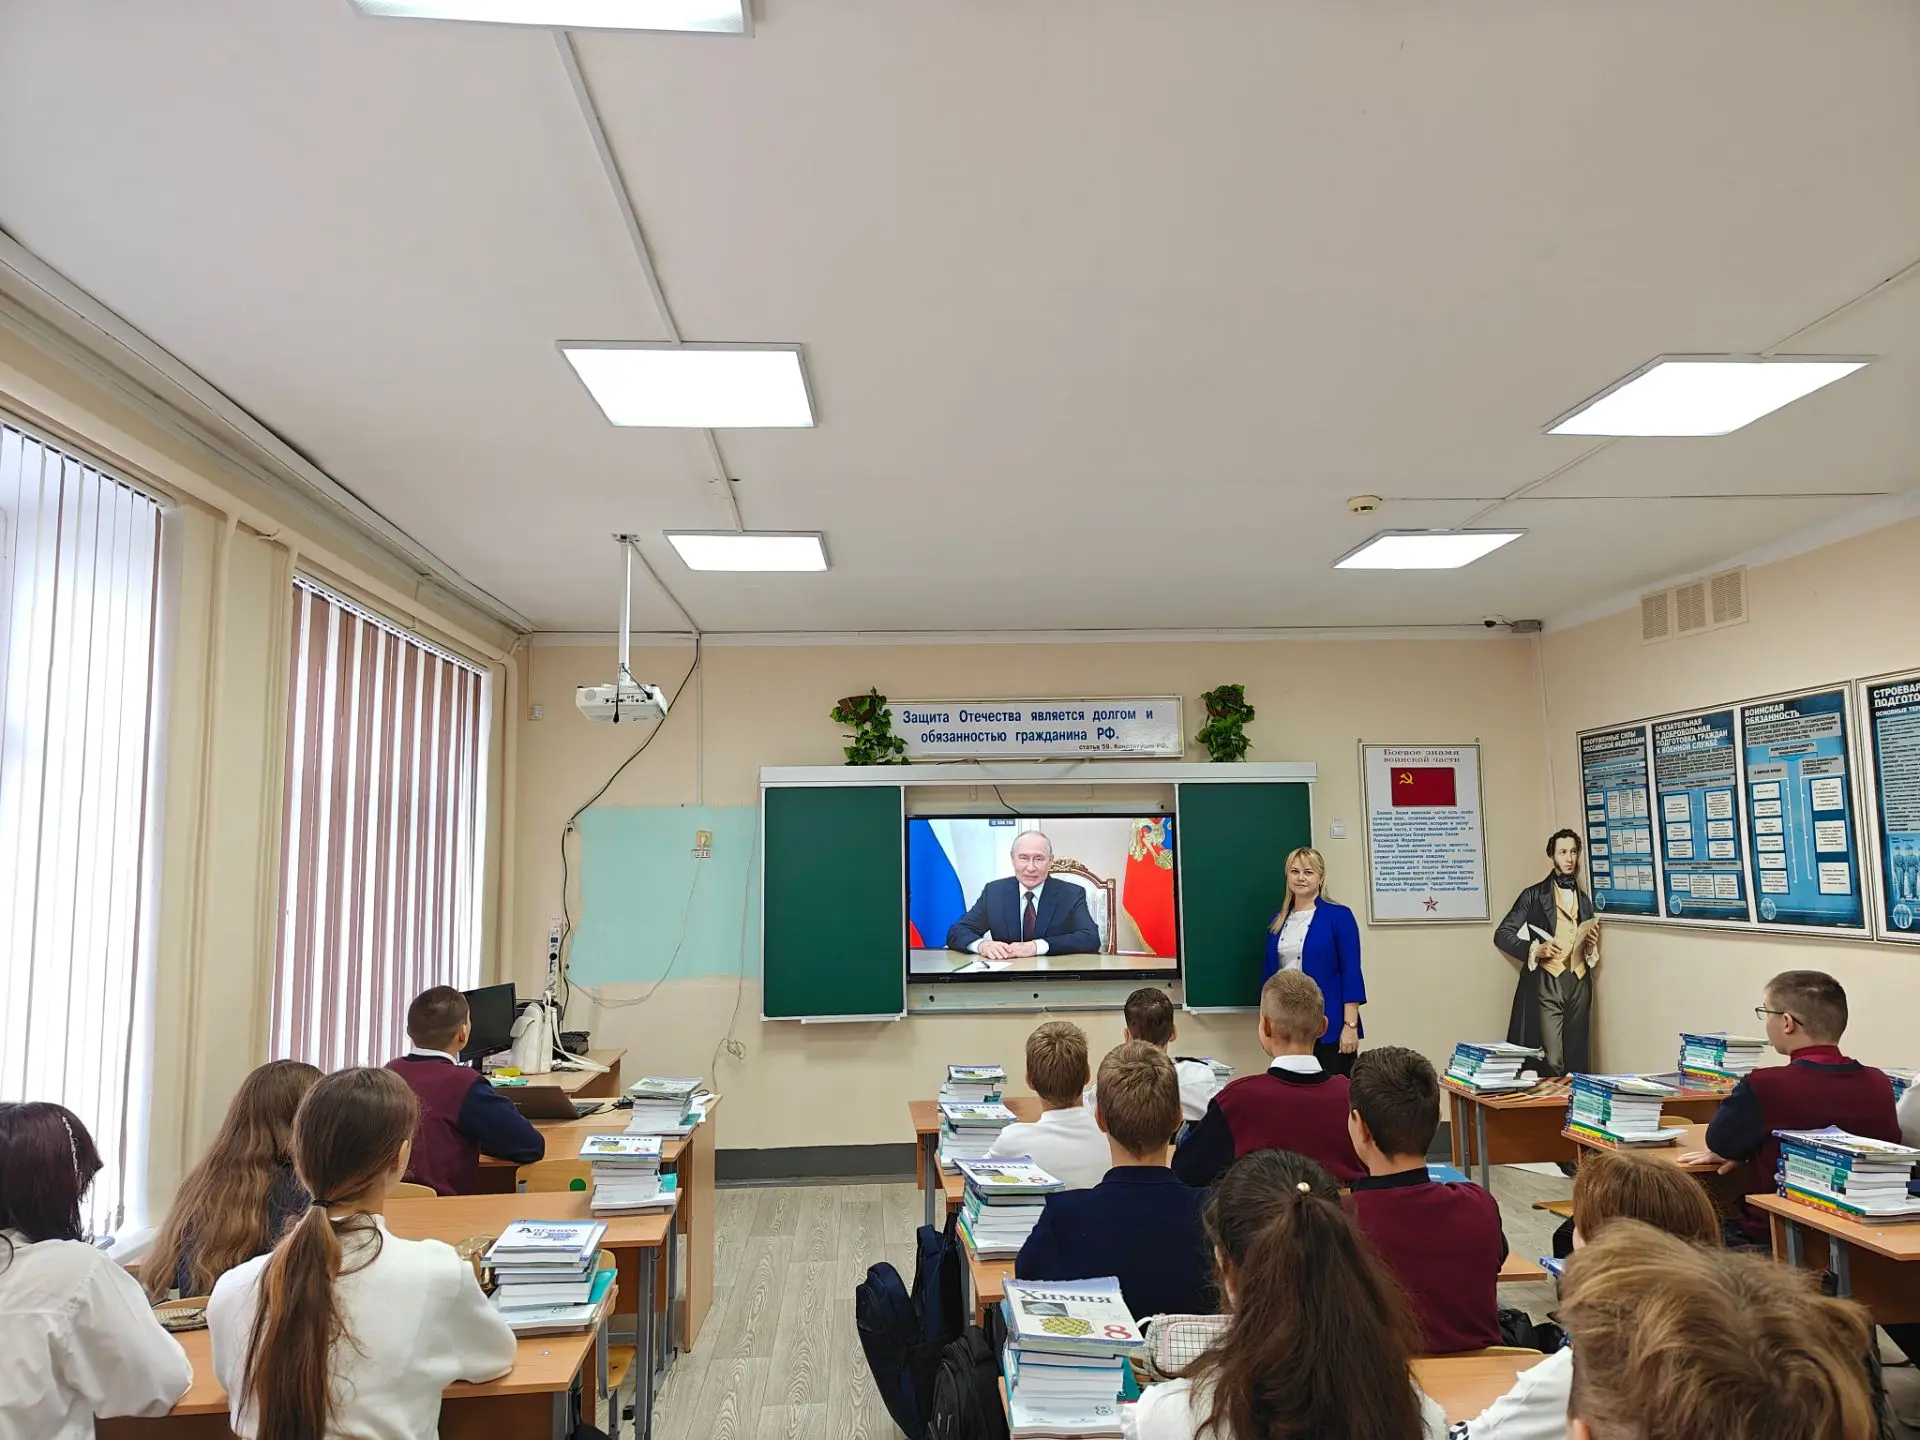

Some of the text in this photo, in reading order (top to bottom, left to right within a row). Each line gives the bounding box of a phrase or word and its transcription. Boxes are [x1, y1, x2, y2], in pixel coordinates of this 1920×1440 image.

[1874, 682, 1920, 698] СТРОЕВАЯ
[903, 710, 1153, 725] Защита Отечества является долгом и
[1744, 704, 1784, 716] ВОИНСКАЯ
[1745, 710, 1800, 725] ОБЯЗАННОСТЬ
[1655, 718, 1702, 732] ОБЯЗАТЕЛЬНАЯ
[1661, 725, 1710, 739] ДОБРОВОЛЬНАЯ
[921, 727, 1119, 744] обязанностью гражданина РФ.
[1656, 729, 1728, 747] ПОДГОТОВКА ГРАЖДАН
[1662, 744, 1691, 754] ВОЕННОЙ
[1692, 739, 1718, 748] СЛУЖБЕ
[1016, 1288, 1112, 1303] Химия
[1104, 1324, 1132, 1339] 8
